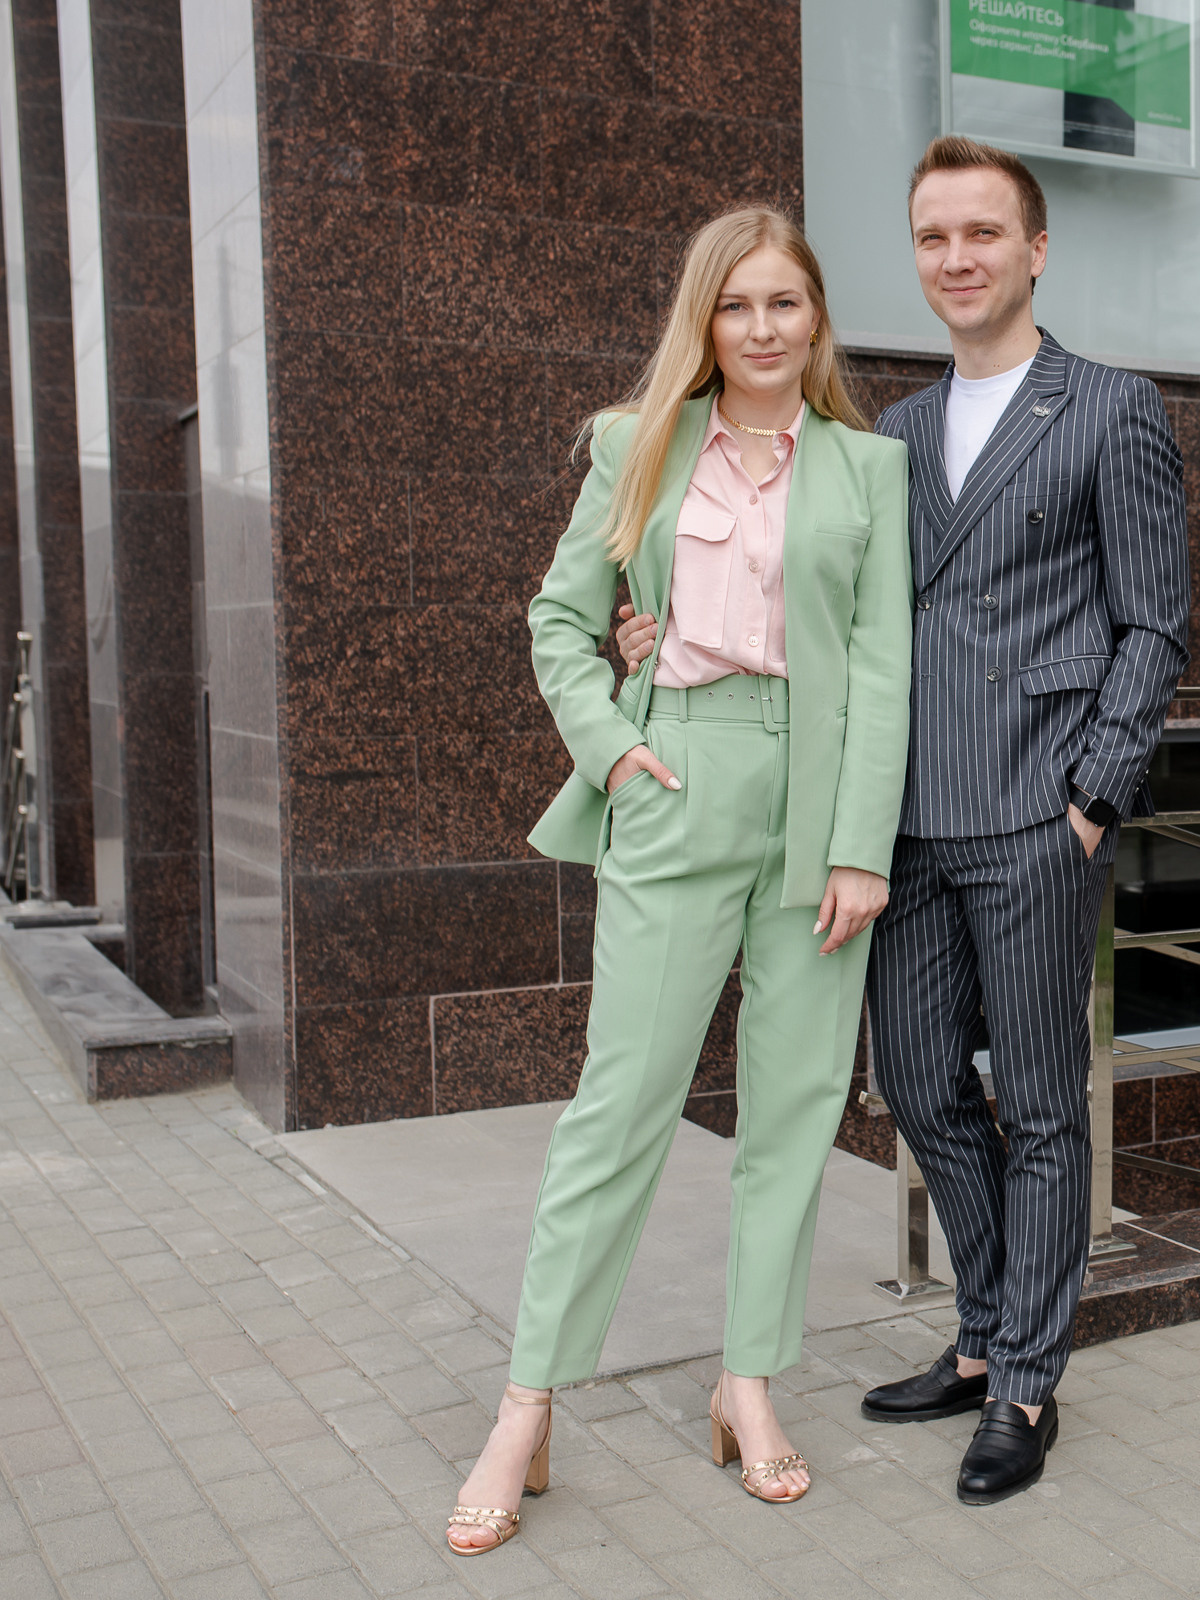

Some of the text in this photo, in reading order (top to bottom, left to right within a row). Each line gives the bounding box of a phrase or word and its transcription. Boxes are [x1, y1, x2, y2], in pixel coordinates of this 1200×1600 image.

[969, 0, 1064, 27] РЕШАЙТЕСЬ
[969, 18, 1109, 53] Оформите ипотеку Сбербанка
[970, 35, 1076, 60] через сервис ДомКлик
